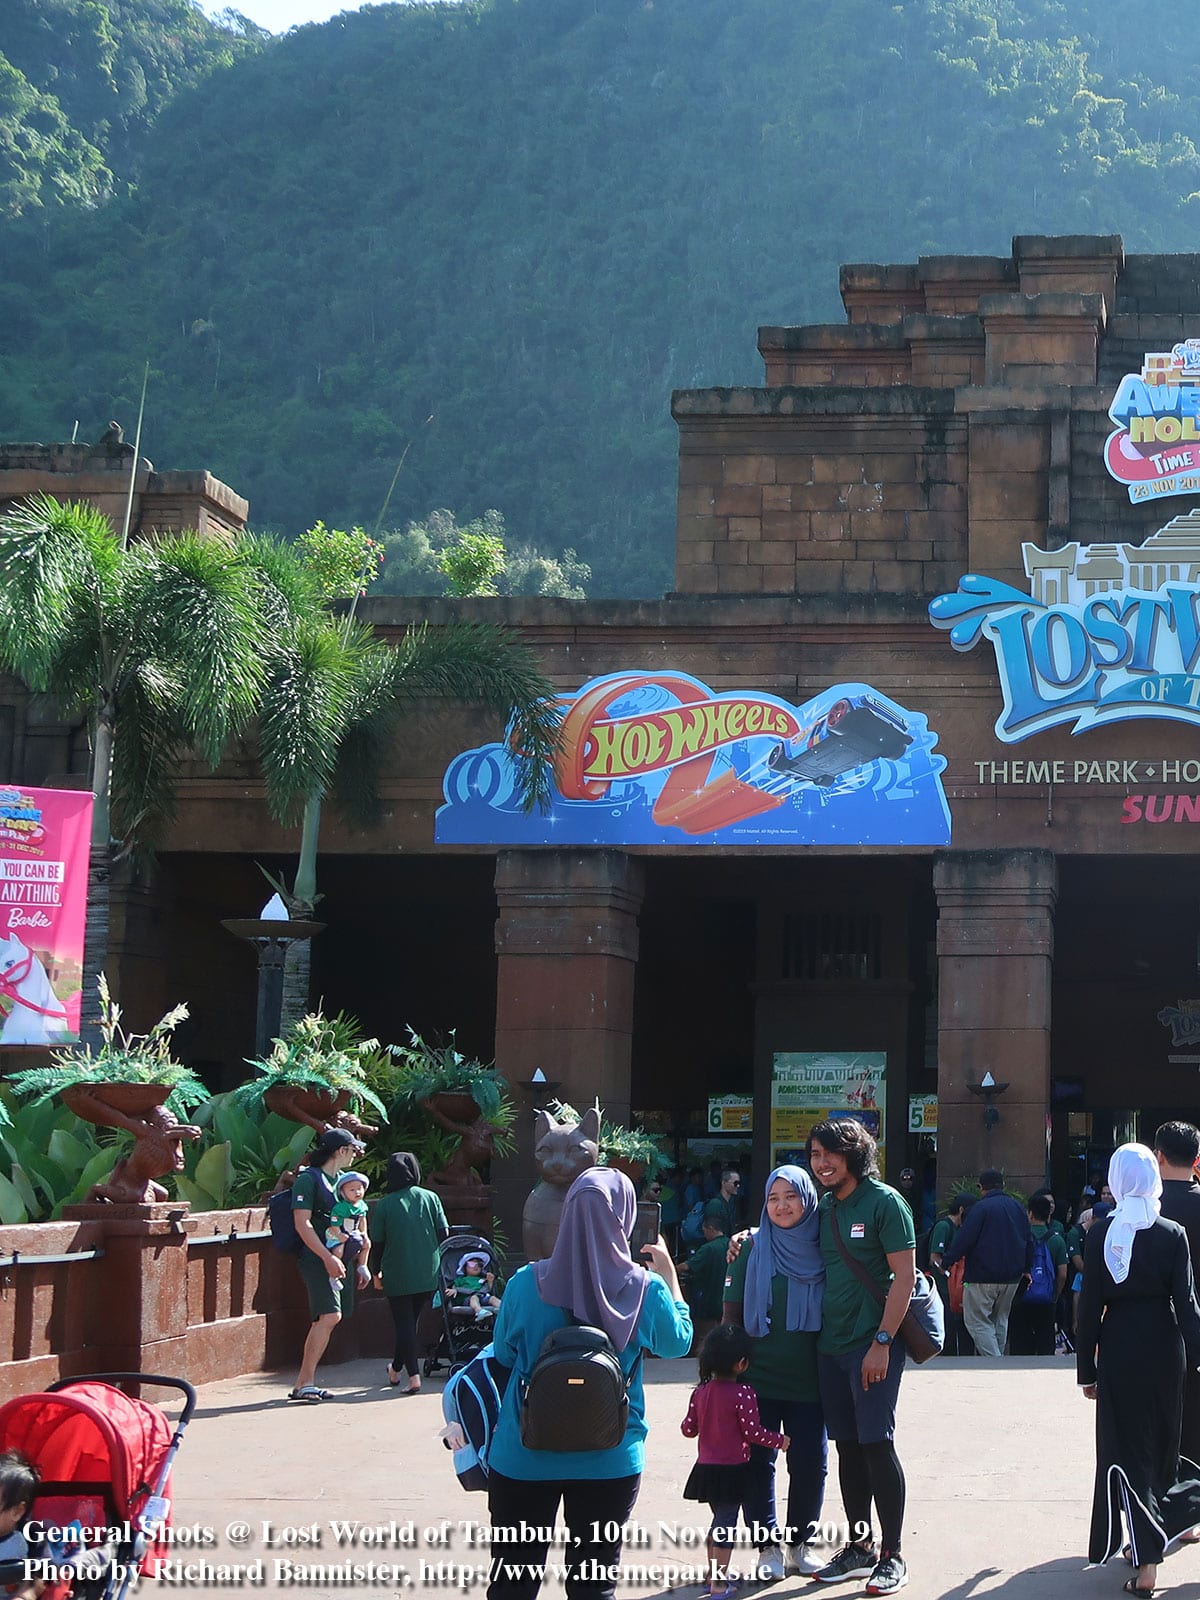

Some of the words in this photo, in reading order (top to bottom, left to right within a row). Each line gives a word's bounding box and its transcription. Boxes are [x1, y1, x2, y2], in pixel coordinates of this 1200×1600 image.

[1149, 451, 1194, 475] TIME
[1133, 485, 1149, 499] 23
[1151, 480, 1176, 495] NOV
[989, 594, 1172, 730] LOST
[1141, 678, 1173, 701] OF
[584, 721, 668, 774] HOT
[660, 703, 789, 763] WHEELS
[974, 760, 1065, 784] THEME
[1074, 760, 1139, 784] PARK
[4, 862, 21, 877] YOU
[24, 864, 46, 879] CAN
[48, 865, 59, 879] BE
[1, 882, 60, 904] ANYTHING
[7, 907, 52, 928] Barbie
[777, 1085, 820, 1094] ADMISSION
[710, 1106, 721, 1128] 6
[911, 1107, 922, 1128] 5
